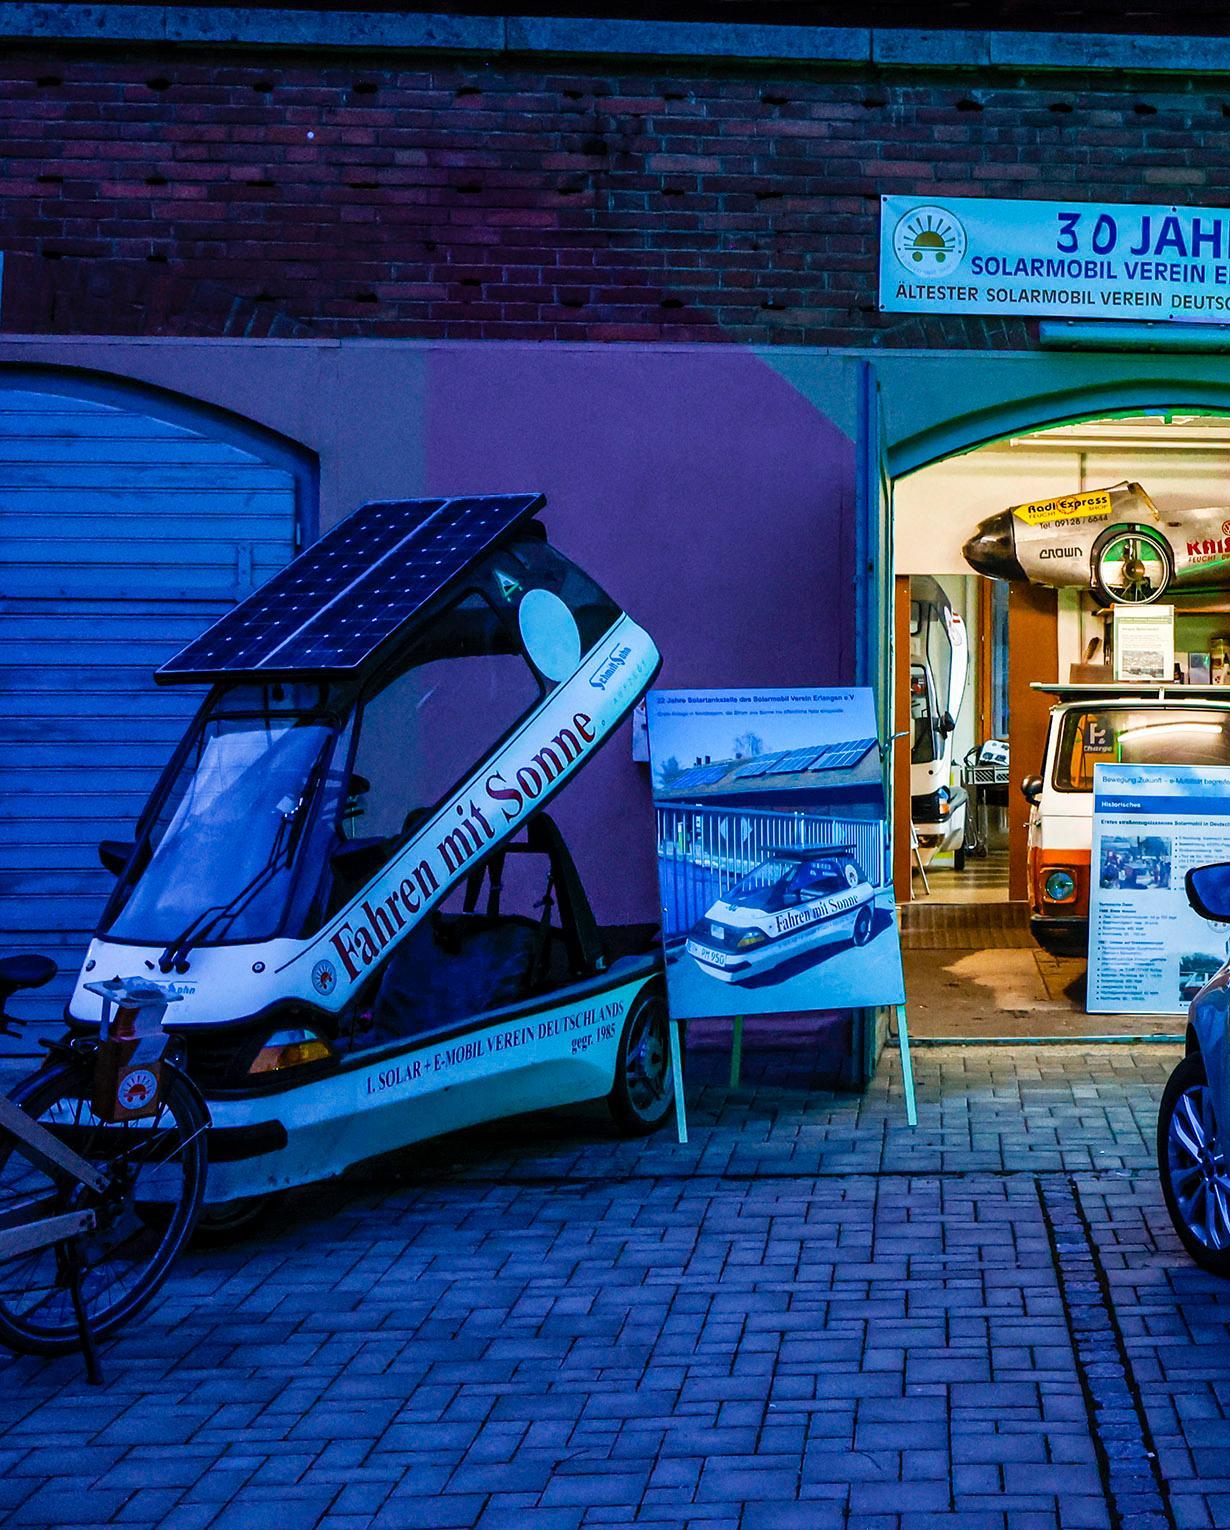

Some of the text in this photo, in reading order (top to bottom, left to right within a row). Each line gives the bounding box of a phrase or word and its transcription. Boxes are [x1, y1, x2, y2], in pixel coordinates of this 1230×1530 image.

[971, 256, 1117, 280] SOLARMOBIL
[1124, 261, 1206, 284] VEREIN
[896, 281, 978, 301] ÄLTESTER
[986, 287, 1096, 306] SOLARMOBIL
[1100, 290, 1163, 308] VEREIN
[1028, 496, 1107, 514] Radl Express
[1054, 518, 1081, 528] 09128
[687, 696, 738, 704] Solartankstelle
[753, 695, 790, 703] Solarmobil
[812, 694, 843, 703] Erlangen
[1102, 775, 1137, 785] Bewegung
[1137, 776, 1162, 784] Zukunft
[329, 712, 597, 984] Fahren mit Sonne
[775, 909, 812, 932] Fahren
[812, 901, 829, 918] mit
[828, 896, 859, 913] Sonne
[378, 1060, 422, 1092] SOLAR
[434, 1043, 485, 1073] E-MOBIL
[486, 1025, 536, 1054] VEREIN
[537, 1000, 625, 1040] DEUTSCHLANDS
[571, 1022, 617, 1055] gegr. 1985
